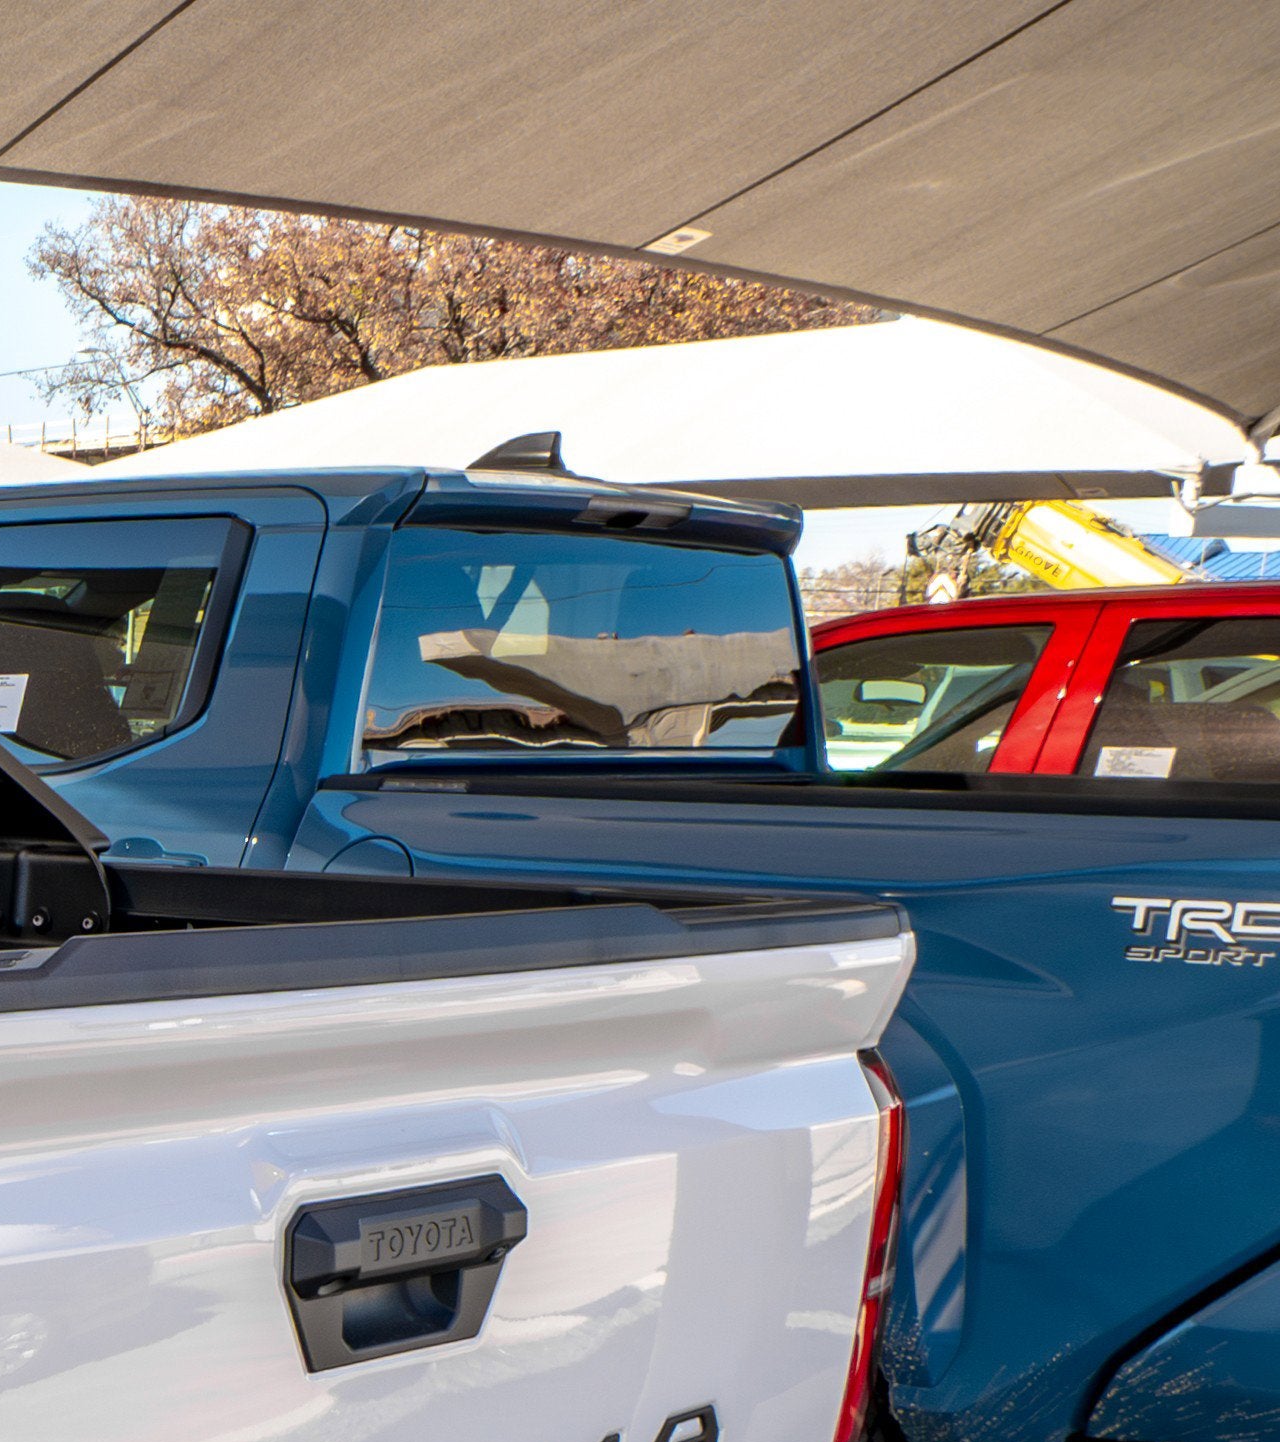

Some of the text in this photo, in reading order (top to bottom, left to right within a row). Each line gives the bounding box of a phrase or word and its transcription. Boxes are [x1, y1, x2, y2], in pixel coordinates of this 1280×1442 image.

[1015, 546, 1061, 577] GROVE
[1110, 896, 1280, 944] TRD
[1124, 946, 1276, 968] SPORT
[368, 1216, 474, 1262] TOYOTA
